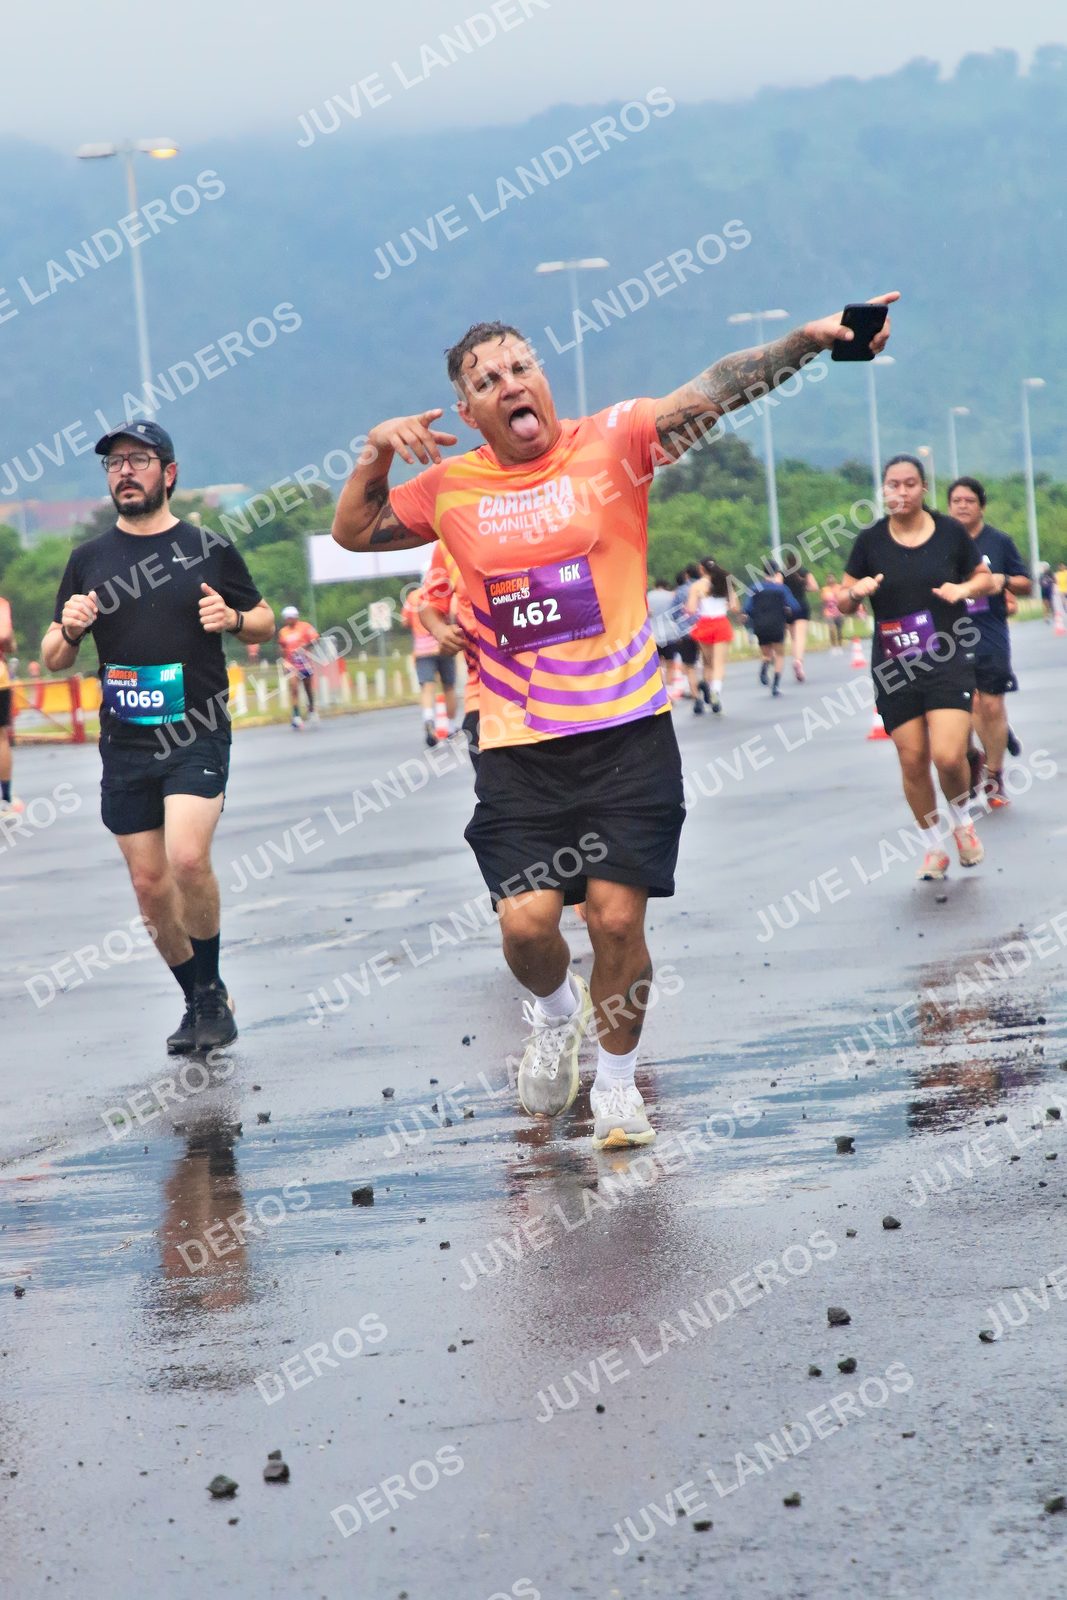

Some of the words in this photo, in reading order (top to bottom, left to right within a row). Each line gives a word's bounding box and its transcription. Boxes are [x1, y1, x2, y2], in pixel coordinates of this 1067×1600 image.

[477, 475, 574, 518] CARRERA
[490, 576, 529, 597] CARRERA
[513, 598, 562, 629] 462
[893, 631, 920, 648] 135
[160, 668, 177, 682] 10K
[116, 689, 165, 709] 1069
